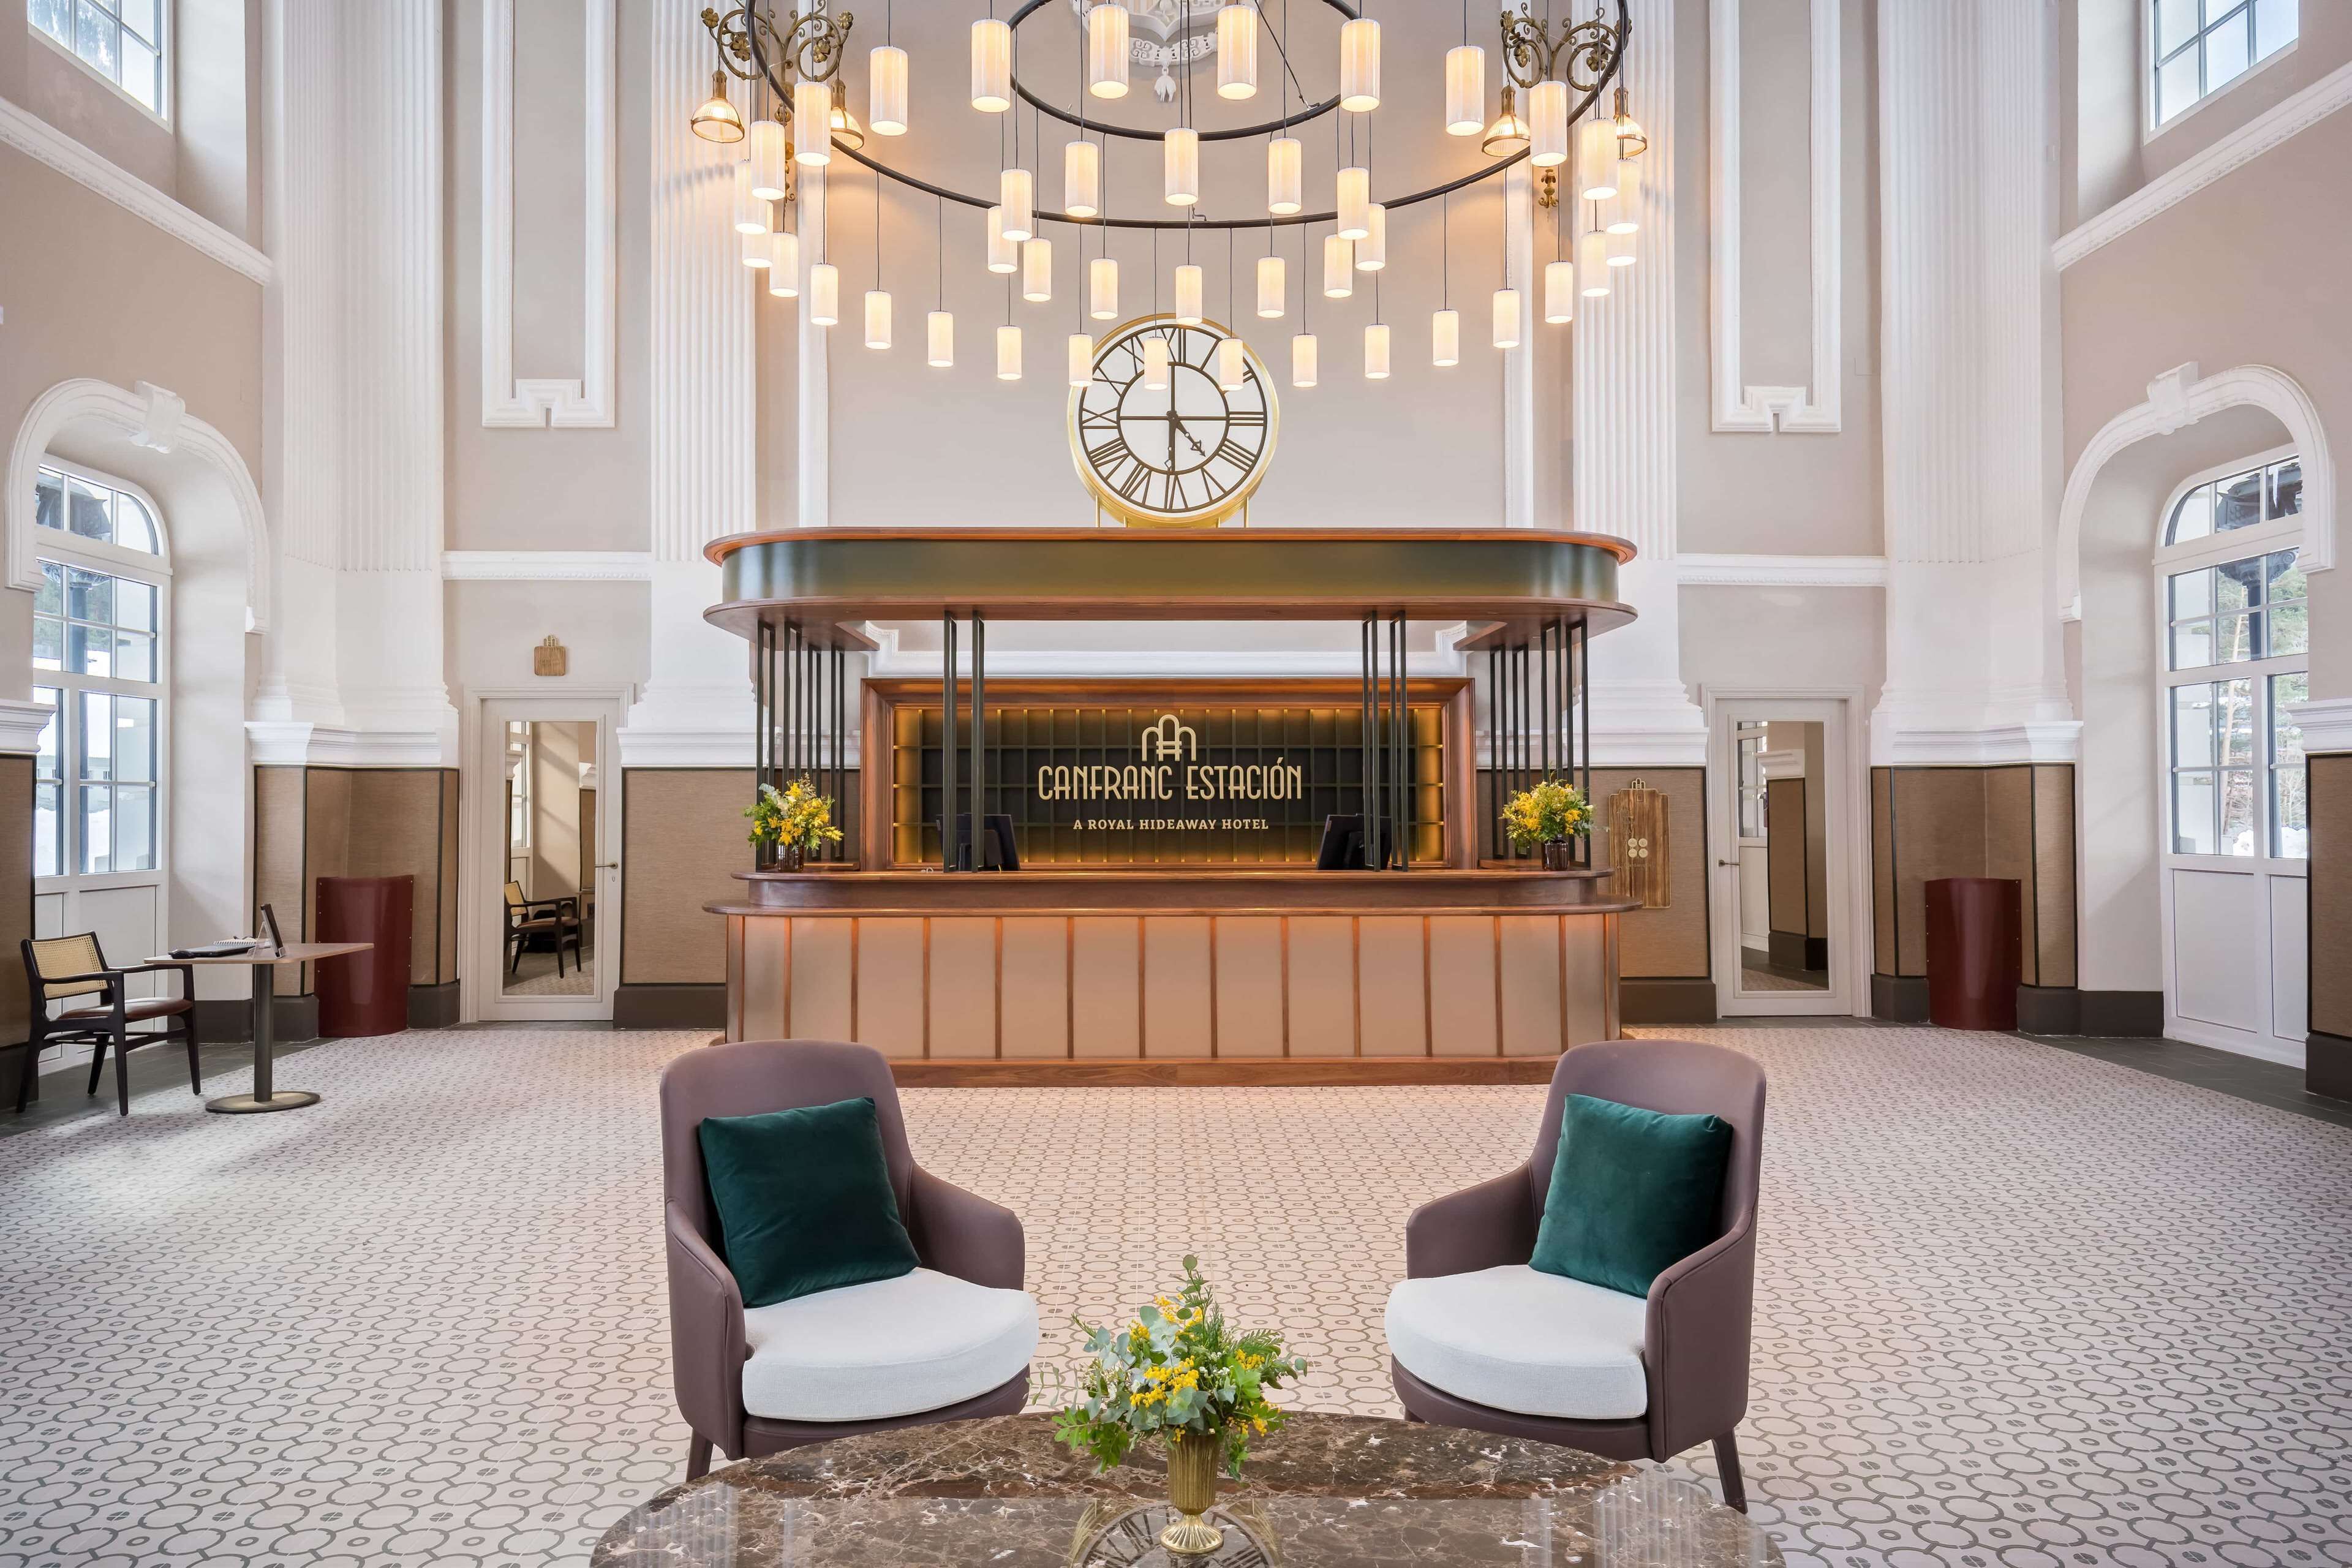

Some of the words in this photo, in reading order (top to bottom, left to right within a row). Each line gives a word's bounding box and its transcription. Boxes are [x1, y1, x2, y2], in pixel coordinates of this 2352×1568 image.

[1038, 765, 1172, 801] CANFRANC
[1186, 756, 1302, 801] ESTACIÓN
[1073, 820, 1083, 830] A
[1088, 820, 1134, 830] ROYAL
[1139, 819, 1216, 830] HIDEAWAY
[1221, 819, 1269, 830] HOTEL
